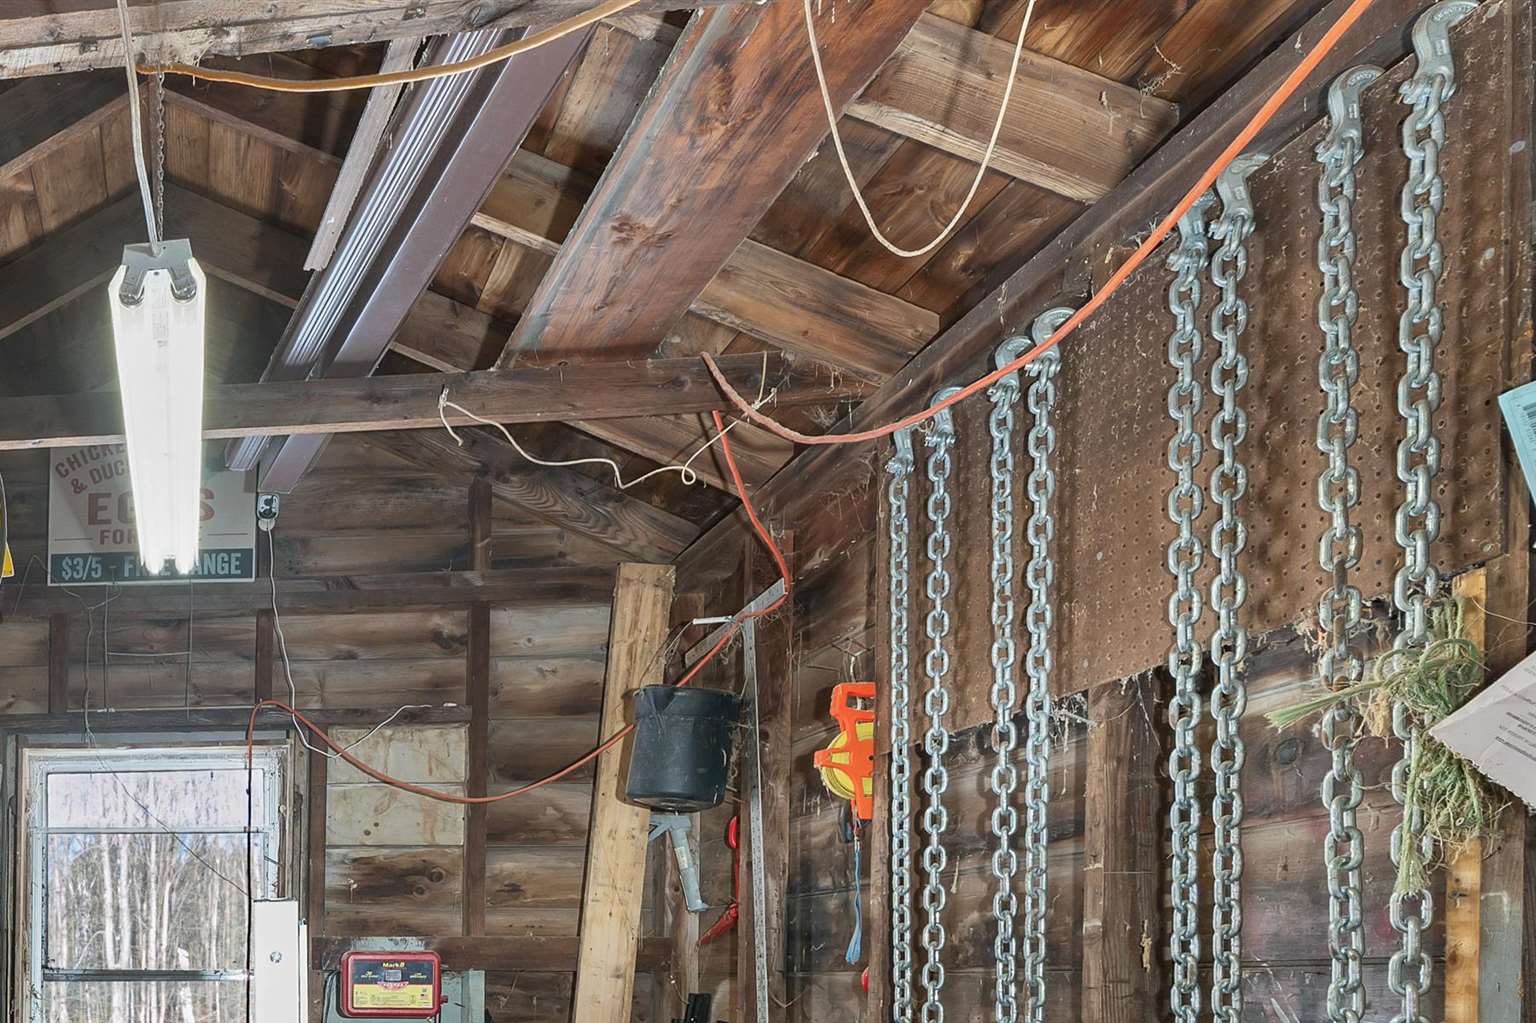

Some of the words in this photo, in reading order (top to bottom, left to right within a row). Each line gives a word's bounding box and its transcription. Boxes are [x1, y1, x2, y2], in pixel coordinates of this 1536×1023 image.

[71, 478, 88, 495] &
[89, 460, 128, 485] DUC
[62, 556, 101, 581] $3/5
[195, 553, 241, 575] ANGE
